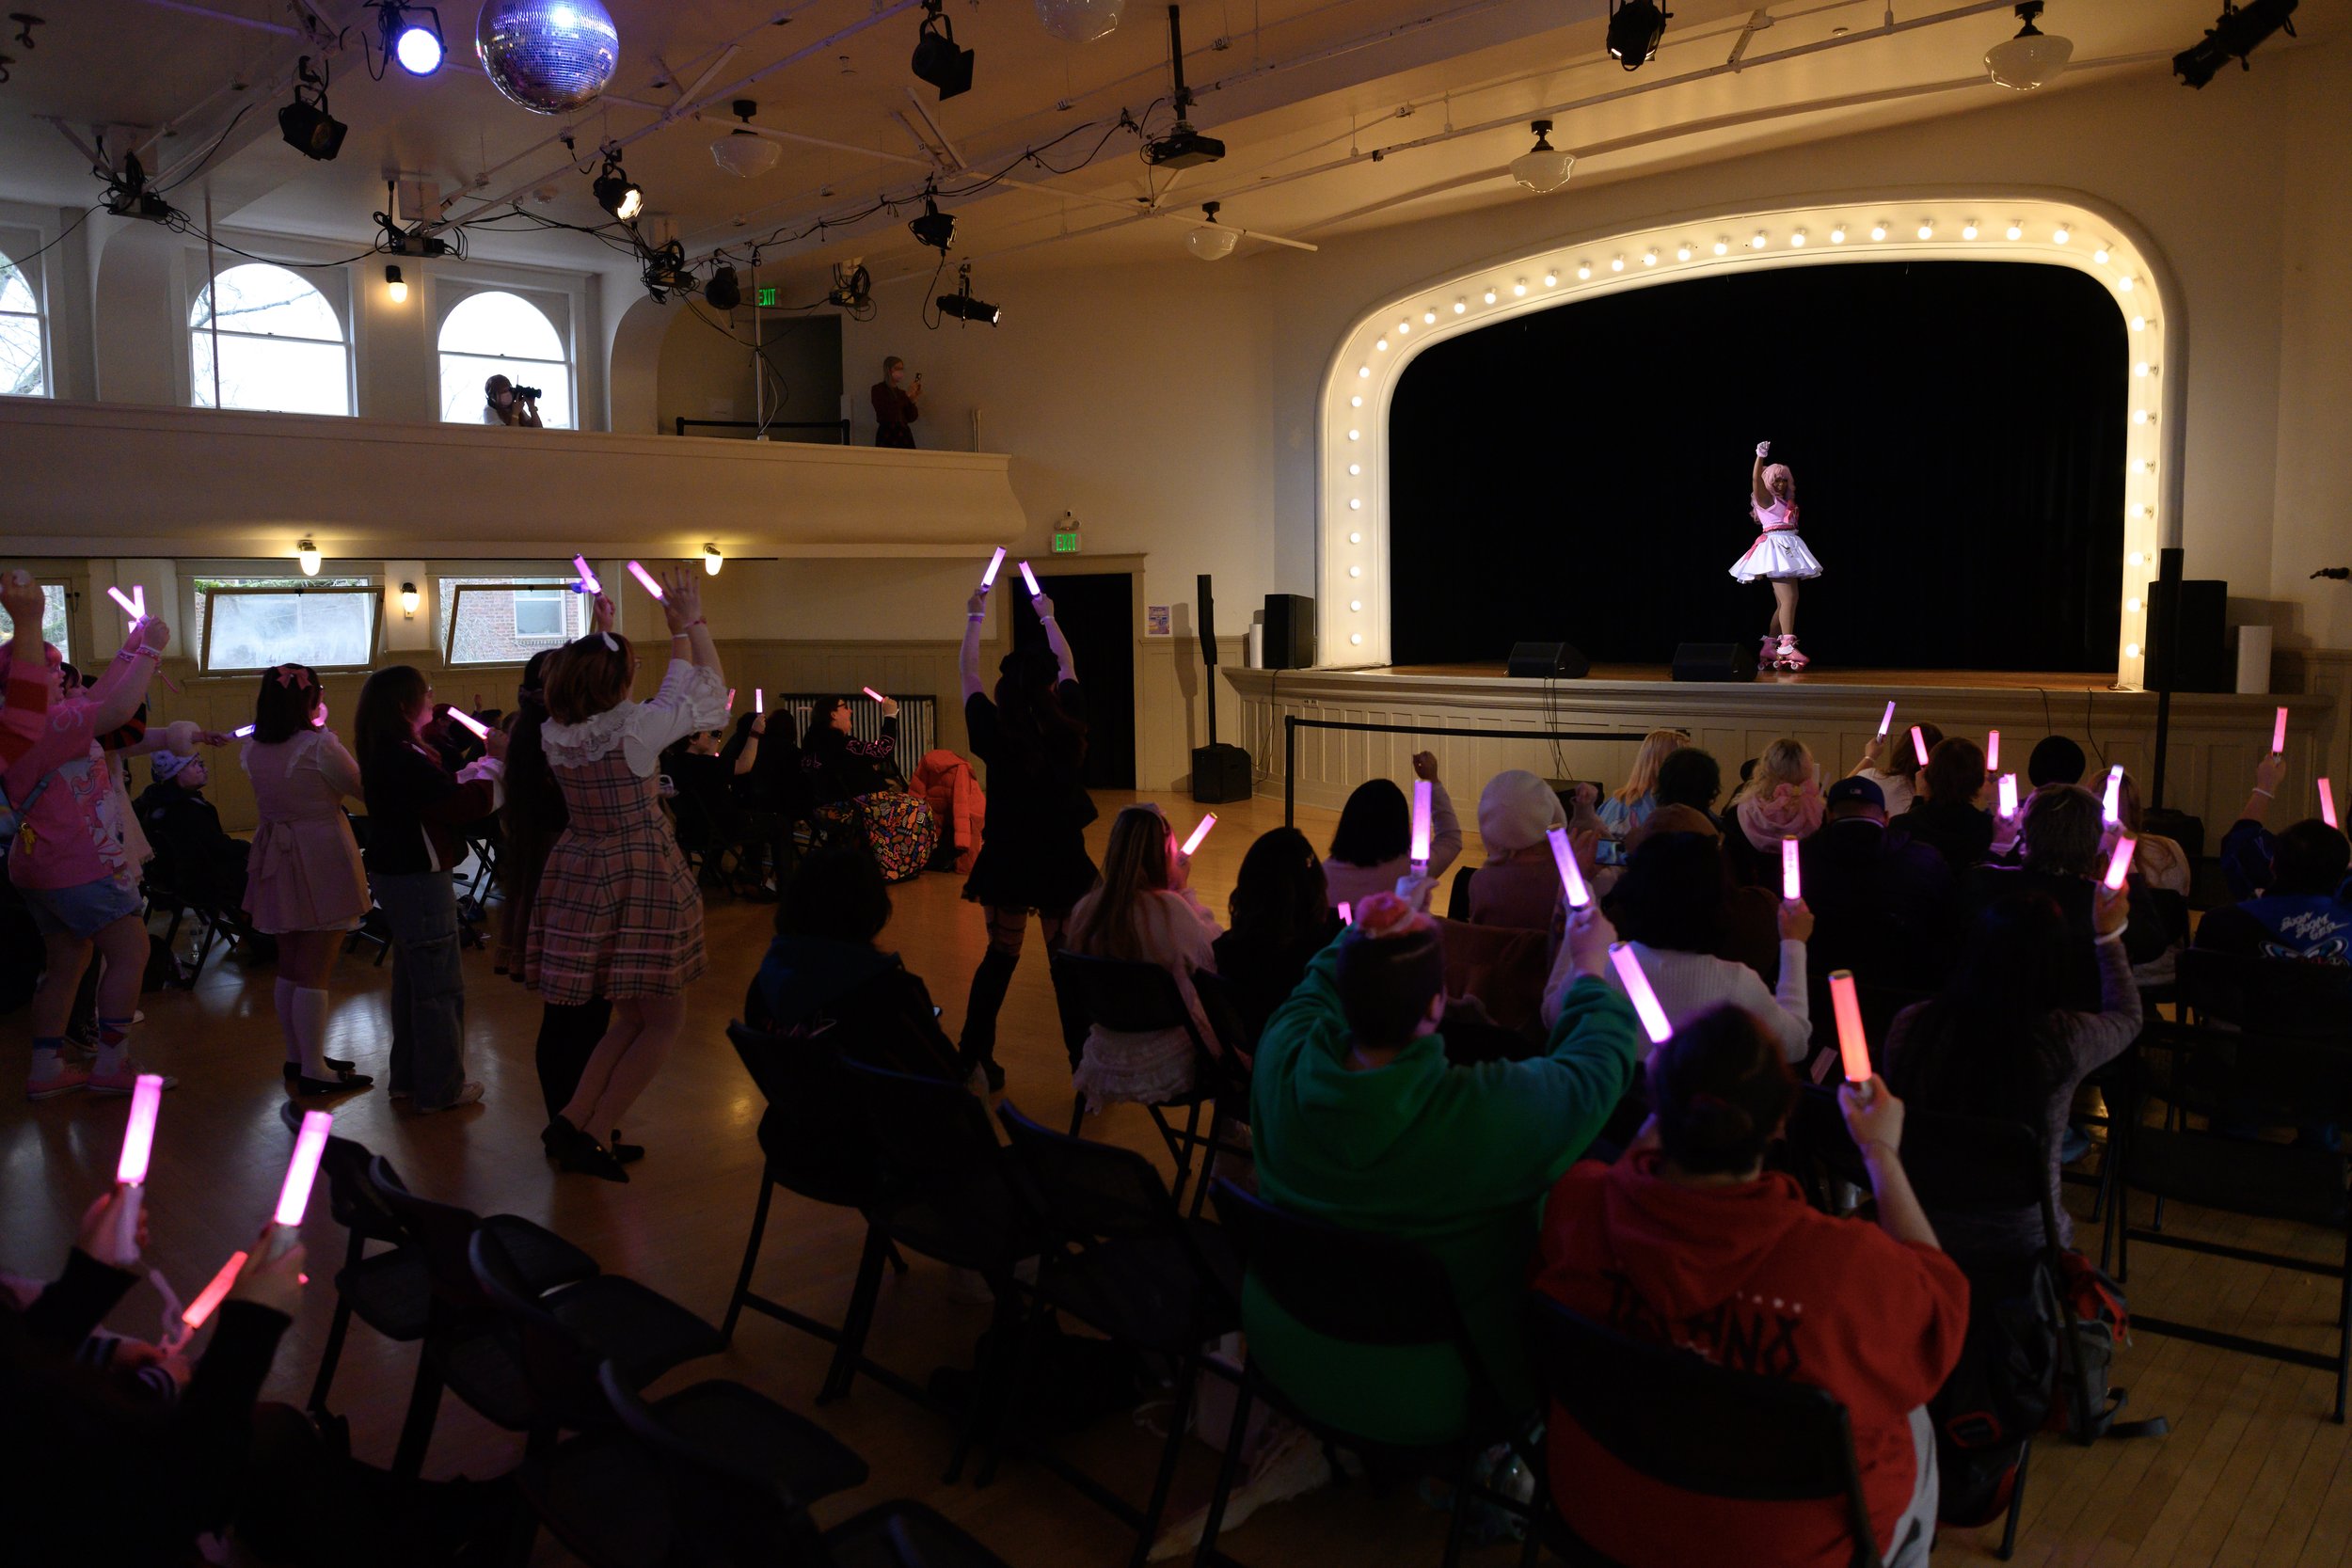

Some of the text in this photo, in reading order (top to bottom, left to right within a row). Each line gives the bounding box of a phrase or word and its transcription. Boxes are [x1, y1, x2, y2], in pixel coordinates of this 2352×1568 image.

[1215, 39, 1222, 47] 10
[758, 288, 775, 306] EXIT
[1056, 533, 1076, 551] EXIT
